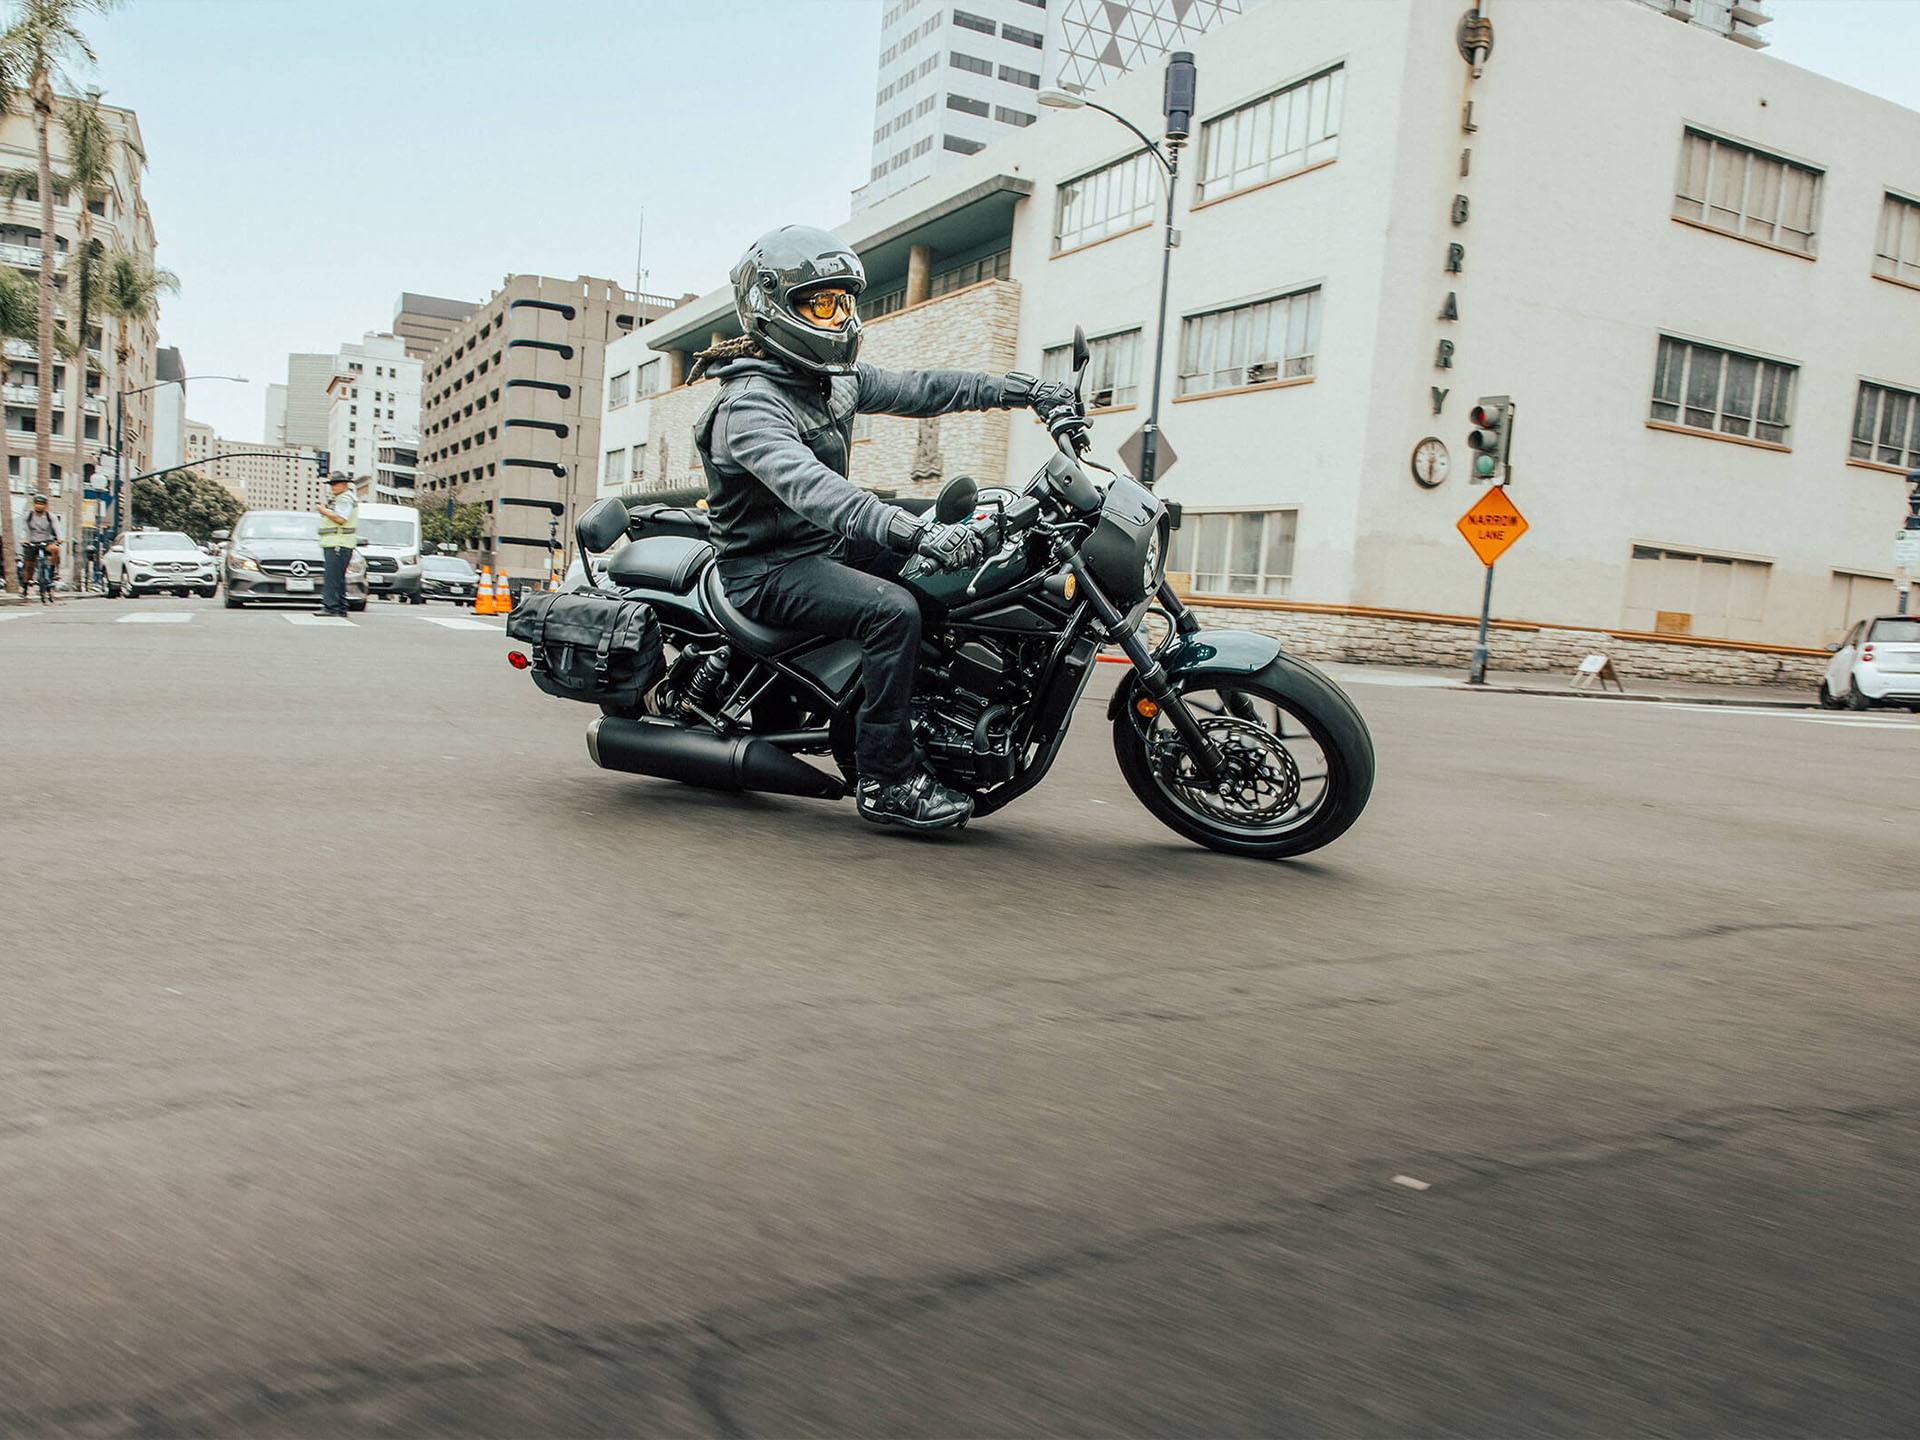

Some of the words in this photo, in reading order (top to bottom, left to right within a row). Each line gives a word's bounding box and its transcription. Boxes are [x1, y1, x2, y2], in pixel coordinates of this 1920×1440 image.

[1431, 101, 1478, 415] LIBRARY
[1468, 514, 1518, 526] NARROW
[1478, 530, 1505, 540] LANE
